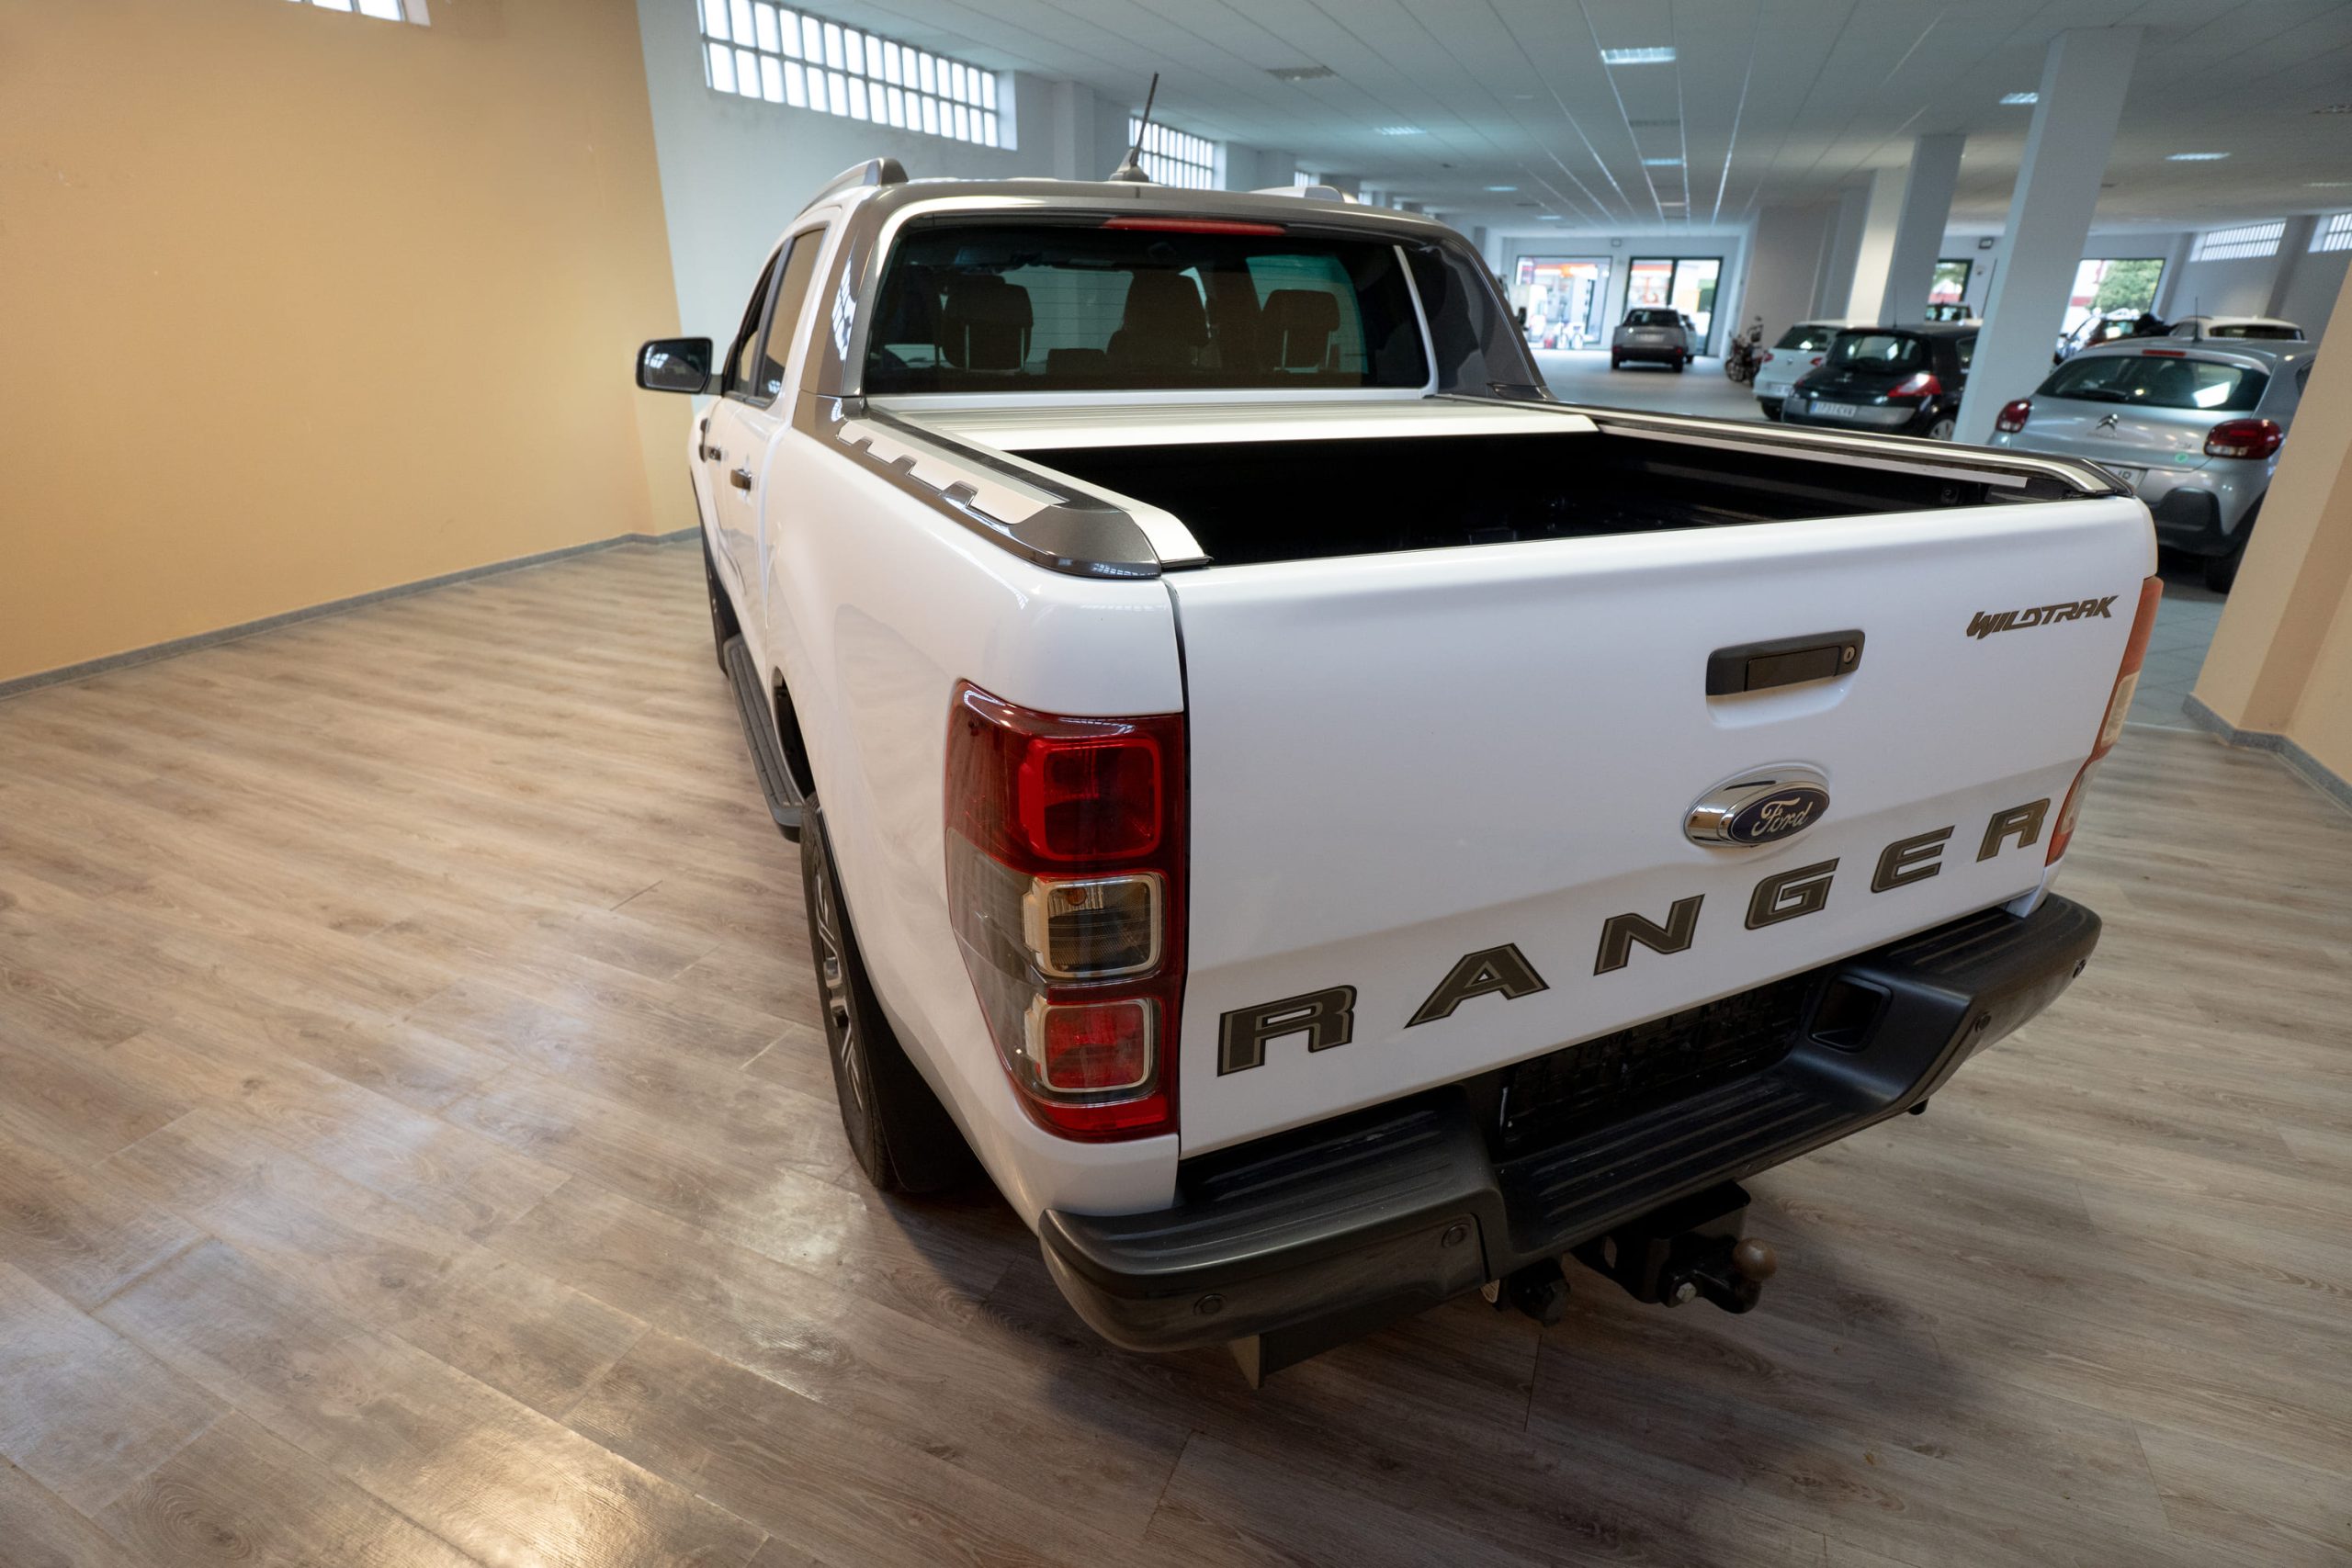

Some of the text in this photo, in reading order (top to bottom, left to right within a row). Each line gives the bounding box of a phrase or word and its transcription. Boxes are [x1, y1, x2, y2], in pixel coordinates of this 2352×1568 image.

[1966, 595, 2118, 640] WILDTRAK
[1750, 796, 1814, 837] Ford
[1217, 797, 2051, 1077] RANGER
